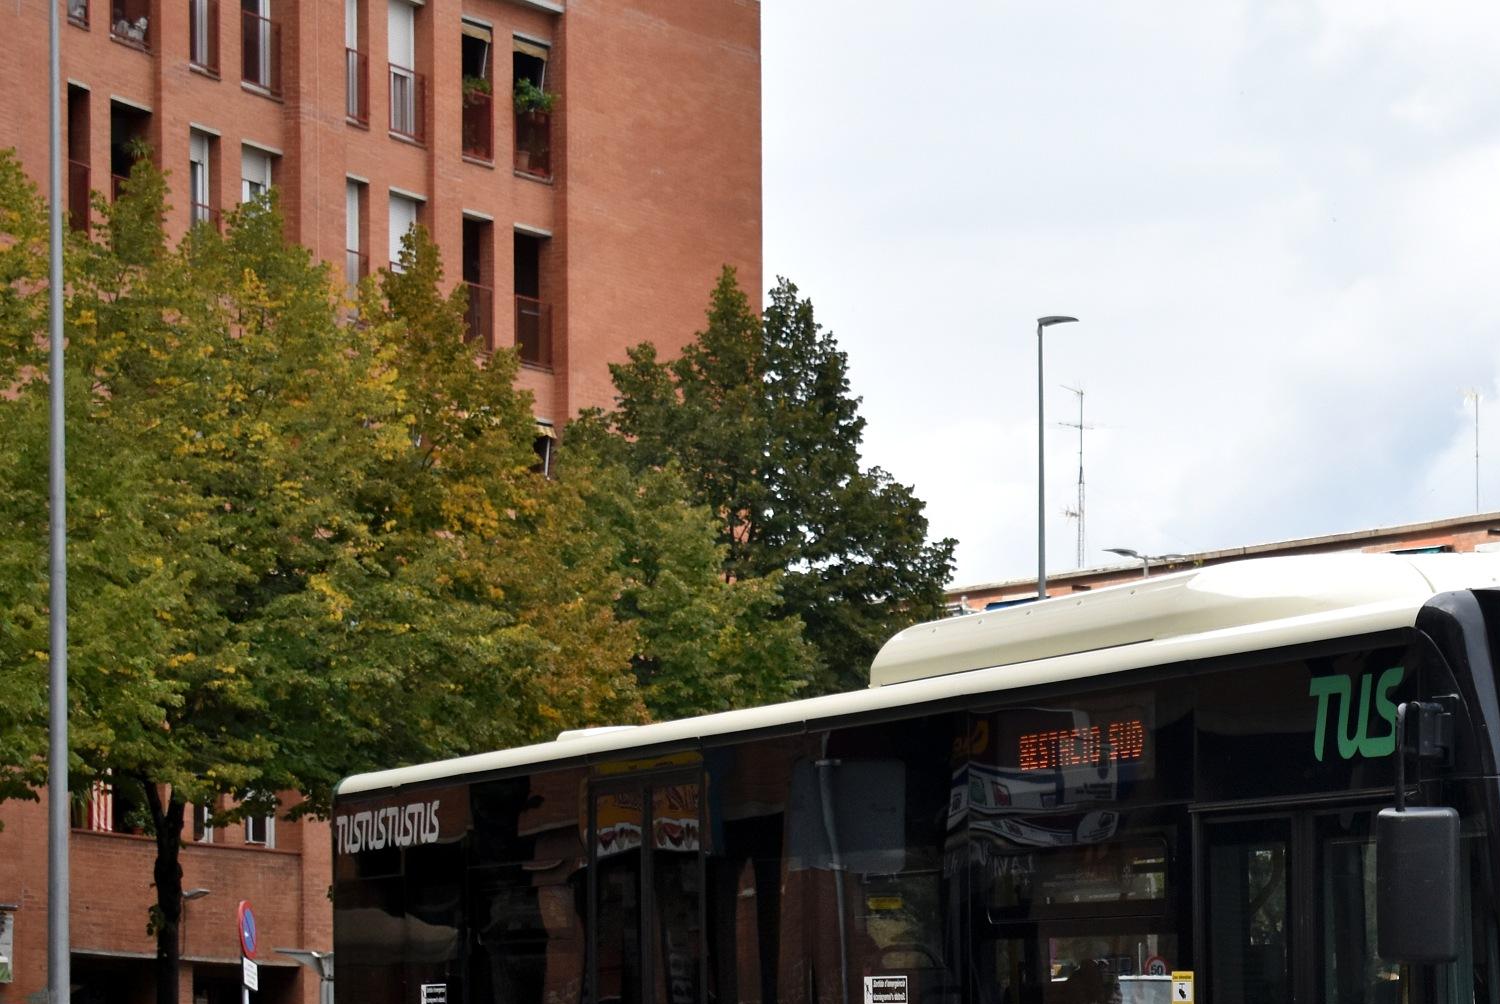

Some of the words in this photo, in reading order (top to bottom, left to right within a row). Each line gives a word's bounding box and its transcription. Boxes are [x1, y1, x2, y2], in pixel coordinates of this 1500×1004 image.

[1309, 666, 1404, 762] TUS
[1109, 719, 1143, 760] SUD
[1150, 965, 1163, 975] 50
